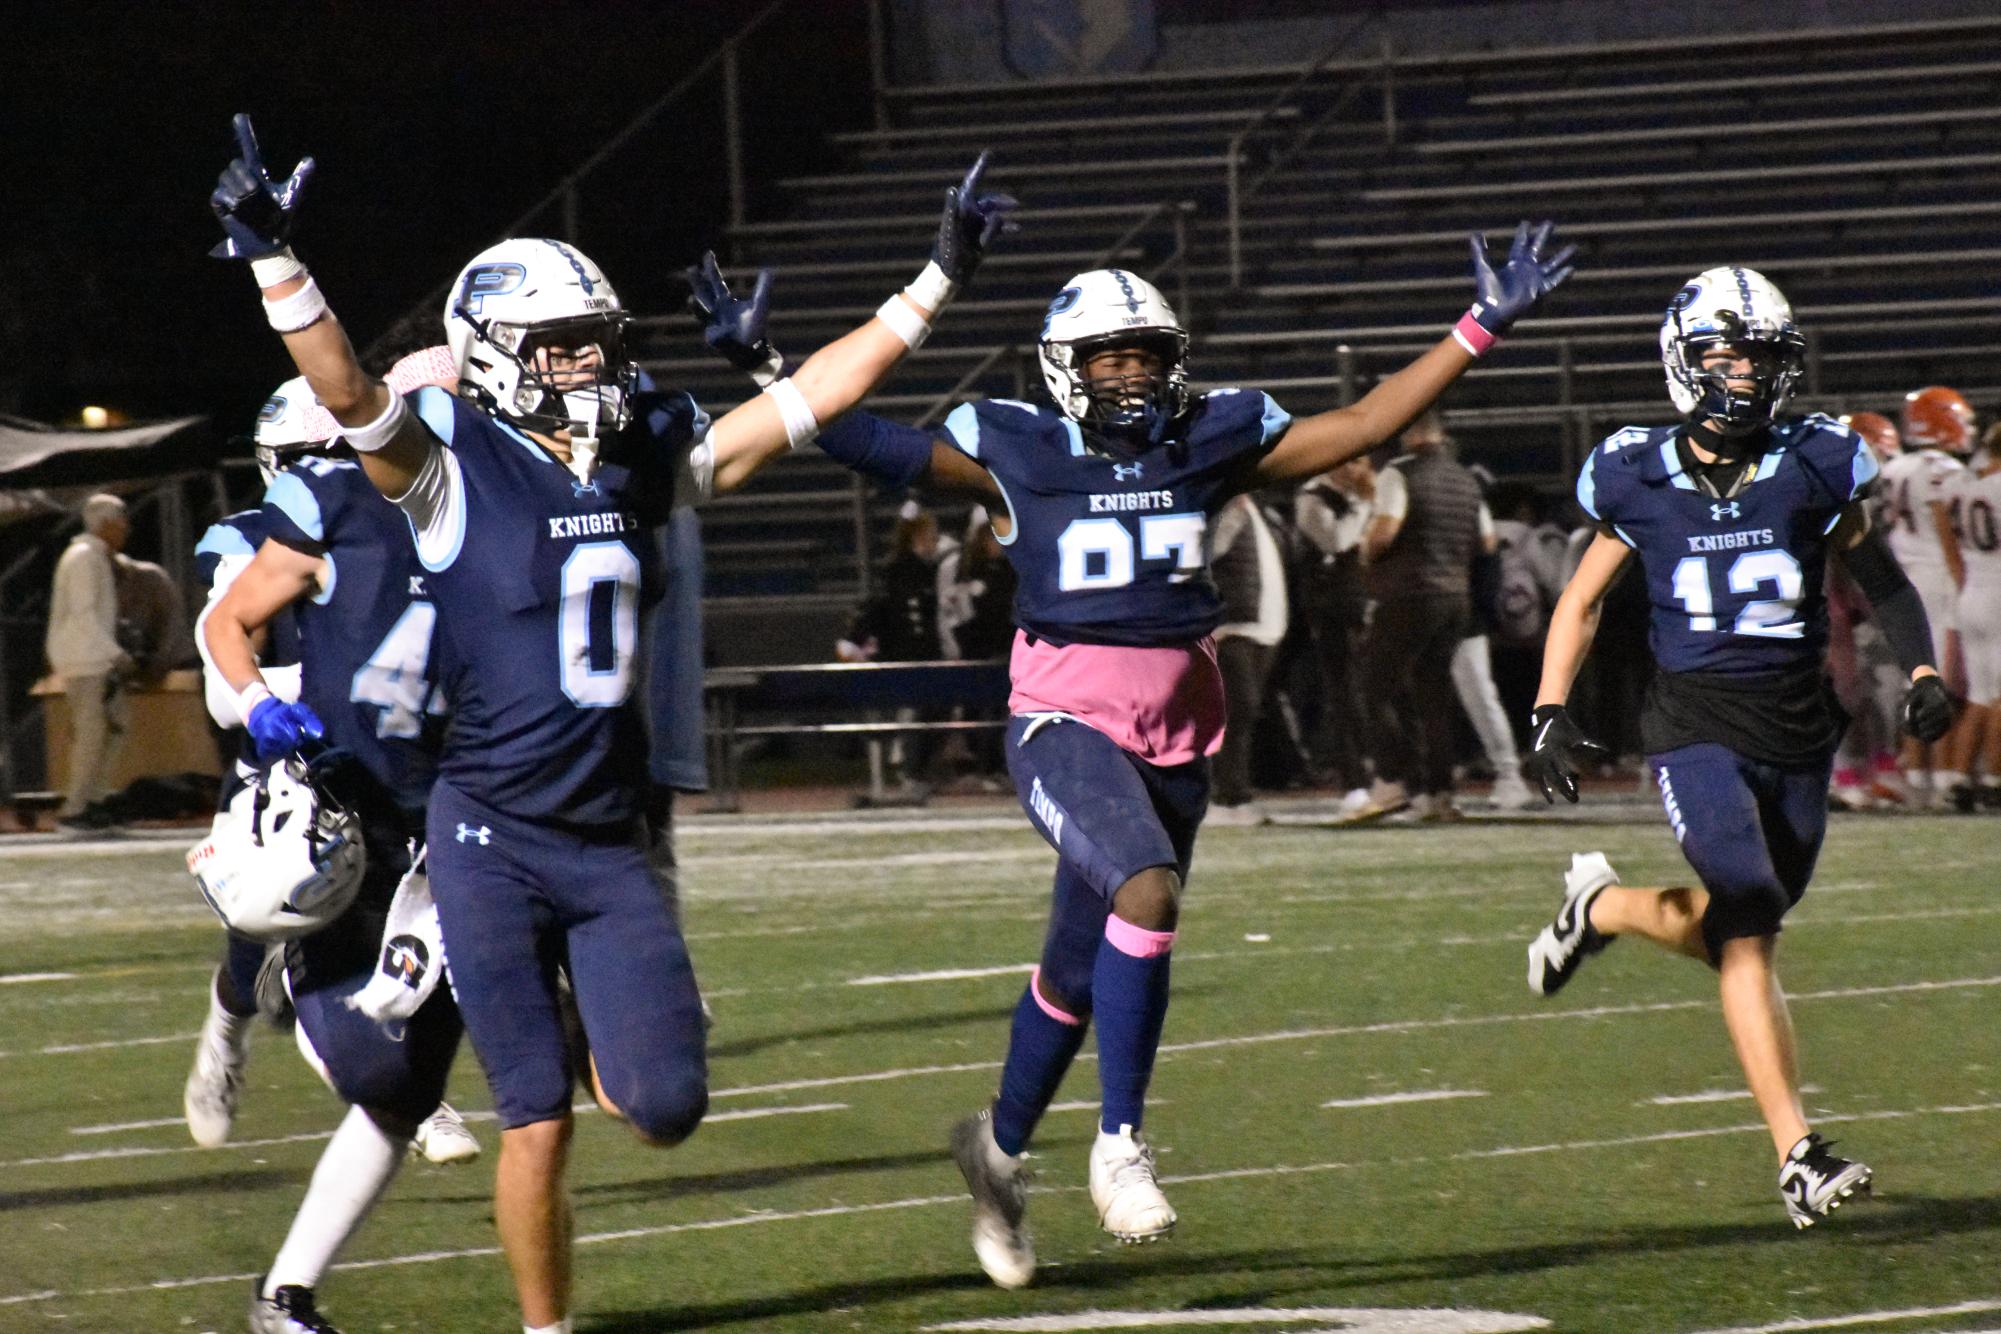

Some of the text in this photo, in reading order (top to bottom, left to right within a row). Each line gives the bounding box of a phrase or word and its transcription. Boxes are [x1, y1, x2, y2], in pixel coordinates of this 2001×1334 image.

[1089, 490, 1174, 513] KNIGHTS
[549, 512, 637, 539] KNIGHTS
[1686, 528, 1775, 553] KNIGHTS
[1671, 548, 1804, 639] 12
[559, 539, 642, 708] 0
